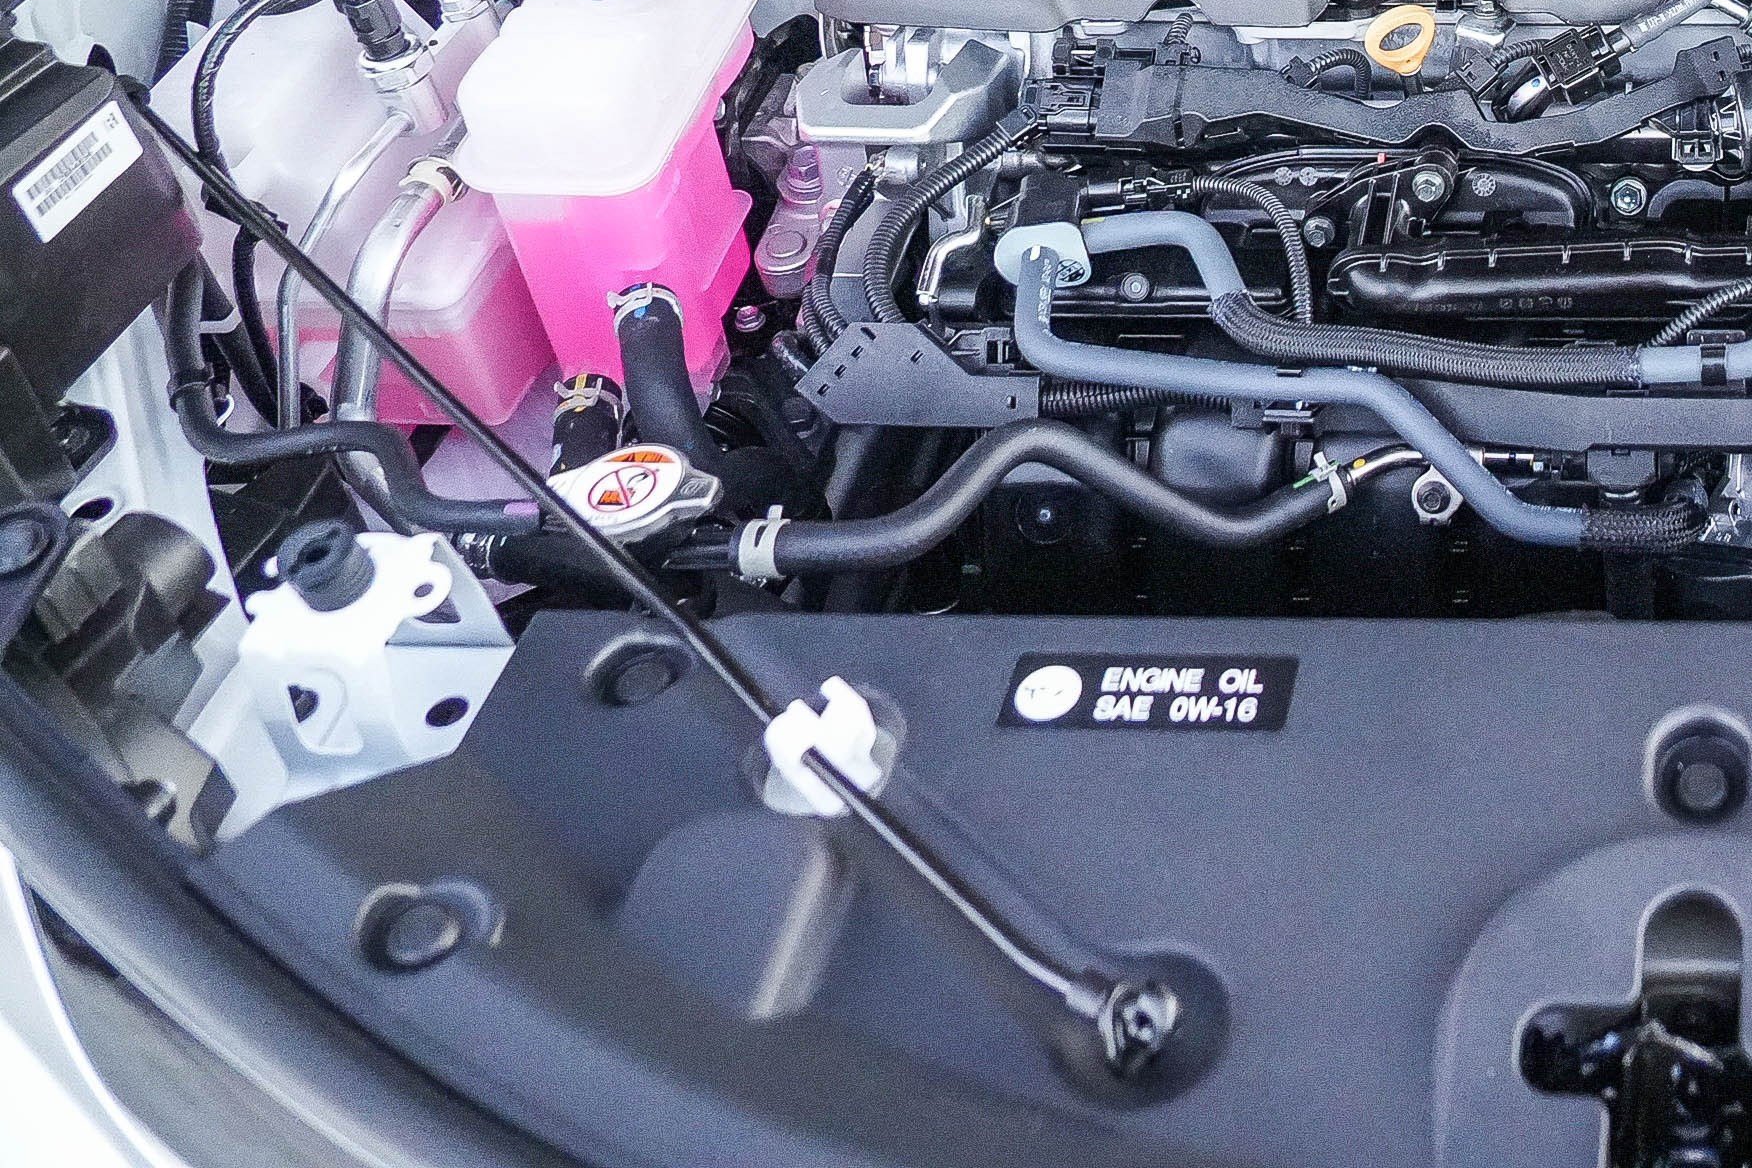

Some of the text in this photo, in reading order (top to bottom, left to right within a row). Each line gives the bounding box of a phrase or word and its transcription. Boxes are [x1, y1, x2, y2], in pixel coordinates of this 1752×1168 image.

[1100, 666, 1206, 694] ENGINE
[1217, 667, 1264, 695] OIL
[1092, 694, 1259, 723] SAE 0W-16
